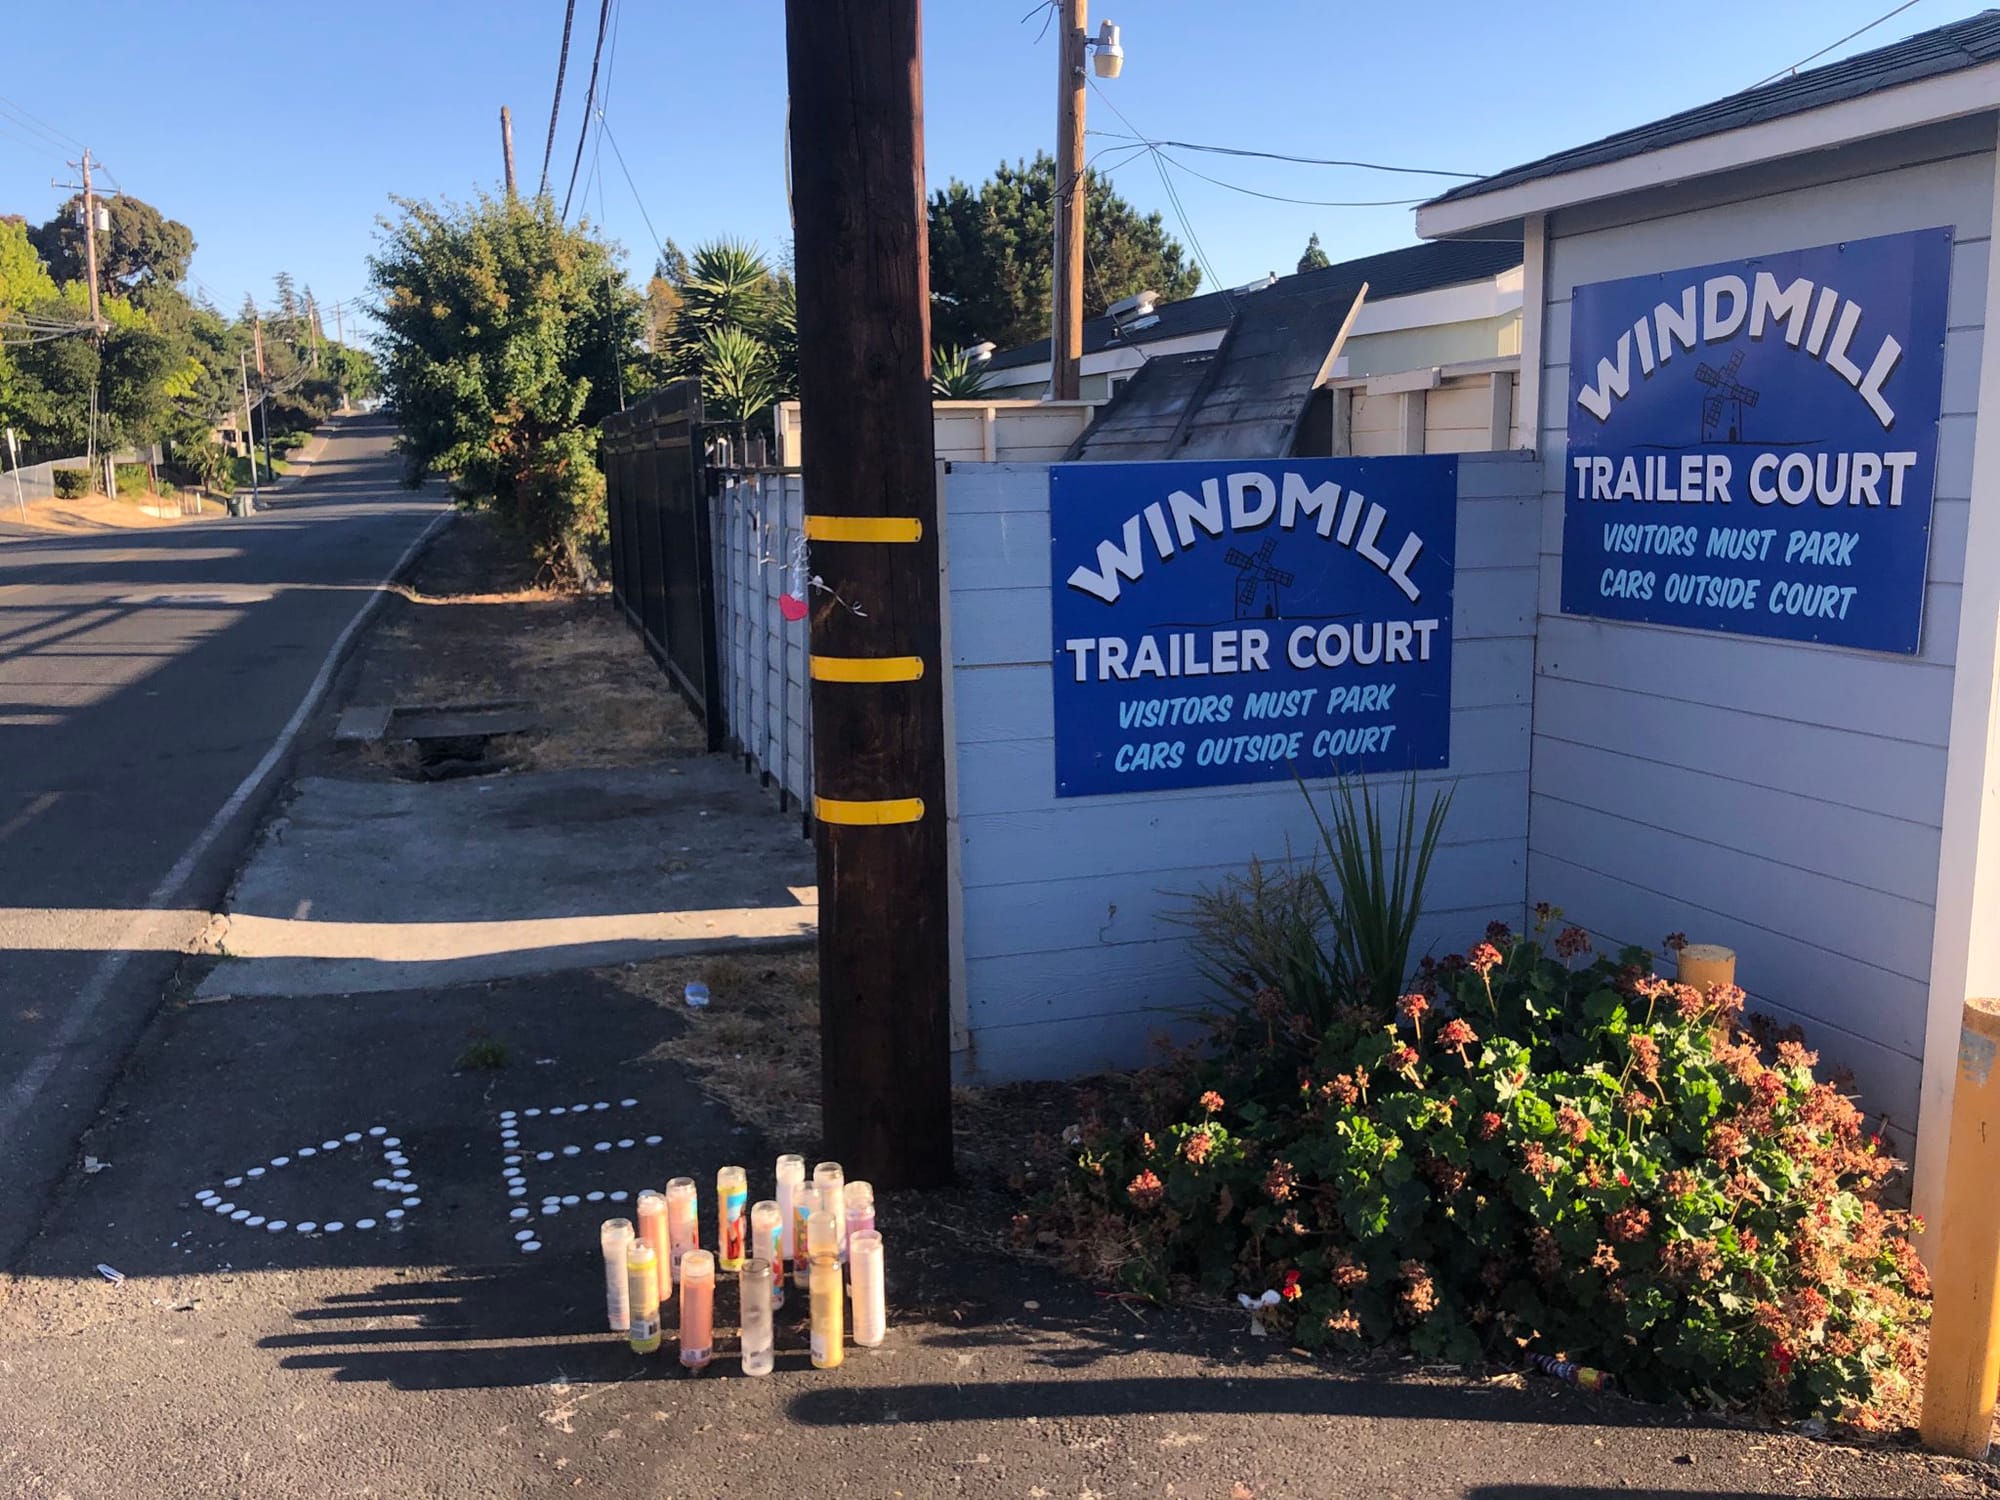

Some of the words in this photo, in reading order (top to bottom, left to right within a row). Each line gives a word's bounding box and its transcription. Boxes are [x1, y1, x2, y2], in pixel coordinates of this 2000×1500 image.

[1577, 271, 1901, 427] WINDMILL
[1573, 454, 1732, 503] TRAILER
[1749, 451, 1917, 507] COURT
[1067, 472, 1423, 602] WINDMILL
[1603, 522, 1697, 557] VISITORS
[1706, 527, 1777, 562] MUST
[1785, 529, 1860, 567] PARK
[1600, 568, 1655, 600] CARS
[1664, 572, 1760, 611] OUTSIDE
[1768, 580, 1857, 621] COURT
[1066, 629, 1270, 682] TRAILER
[1287, 618, 1439, 669] COURT
[1119, 694, 1233, 729] VISITORS
[1243, 687, 1317, 720] MUST
[1326, 682, 1396, 713] PARK
[1114, 742, 1185, 773] CARS
[1197, 731, 1303, 766] OUTSIDE
[1312, 725, 1396, 757] COURT
